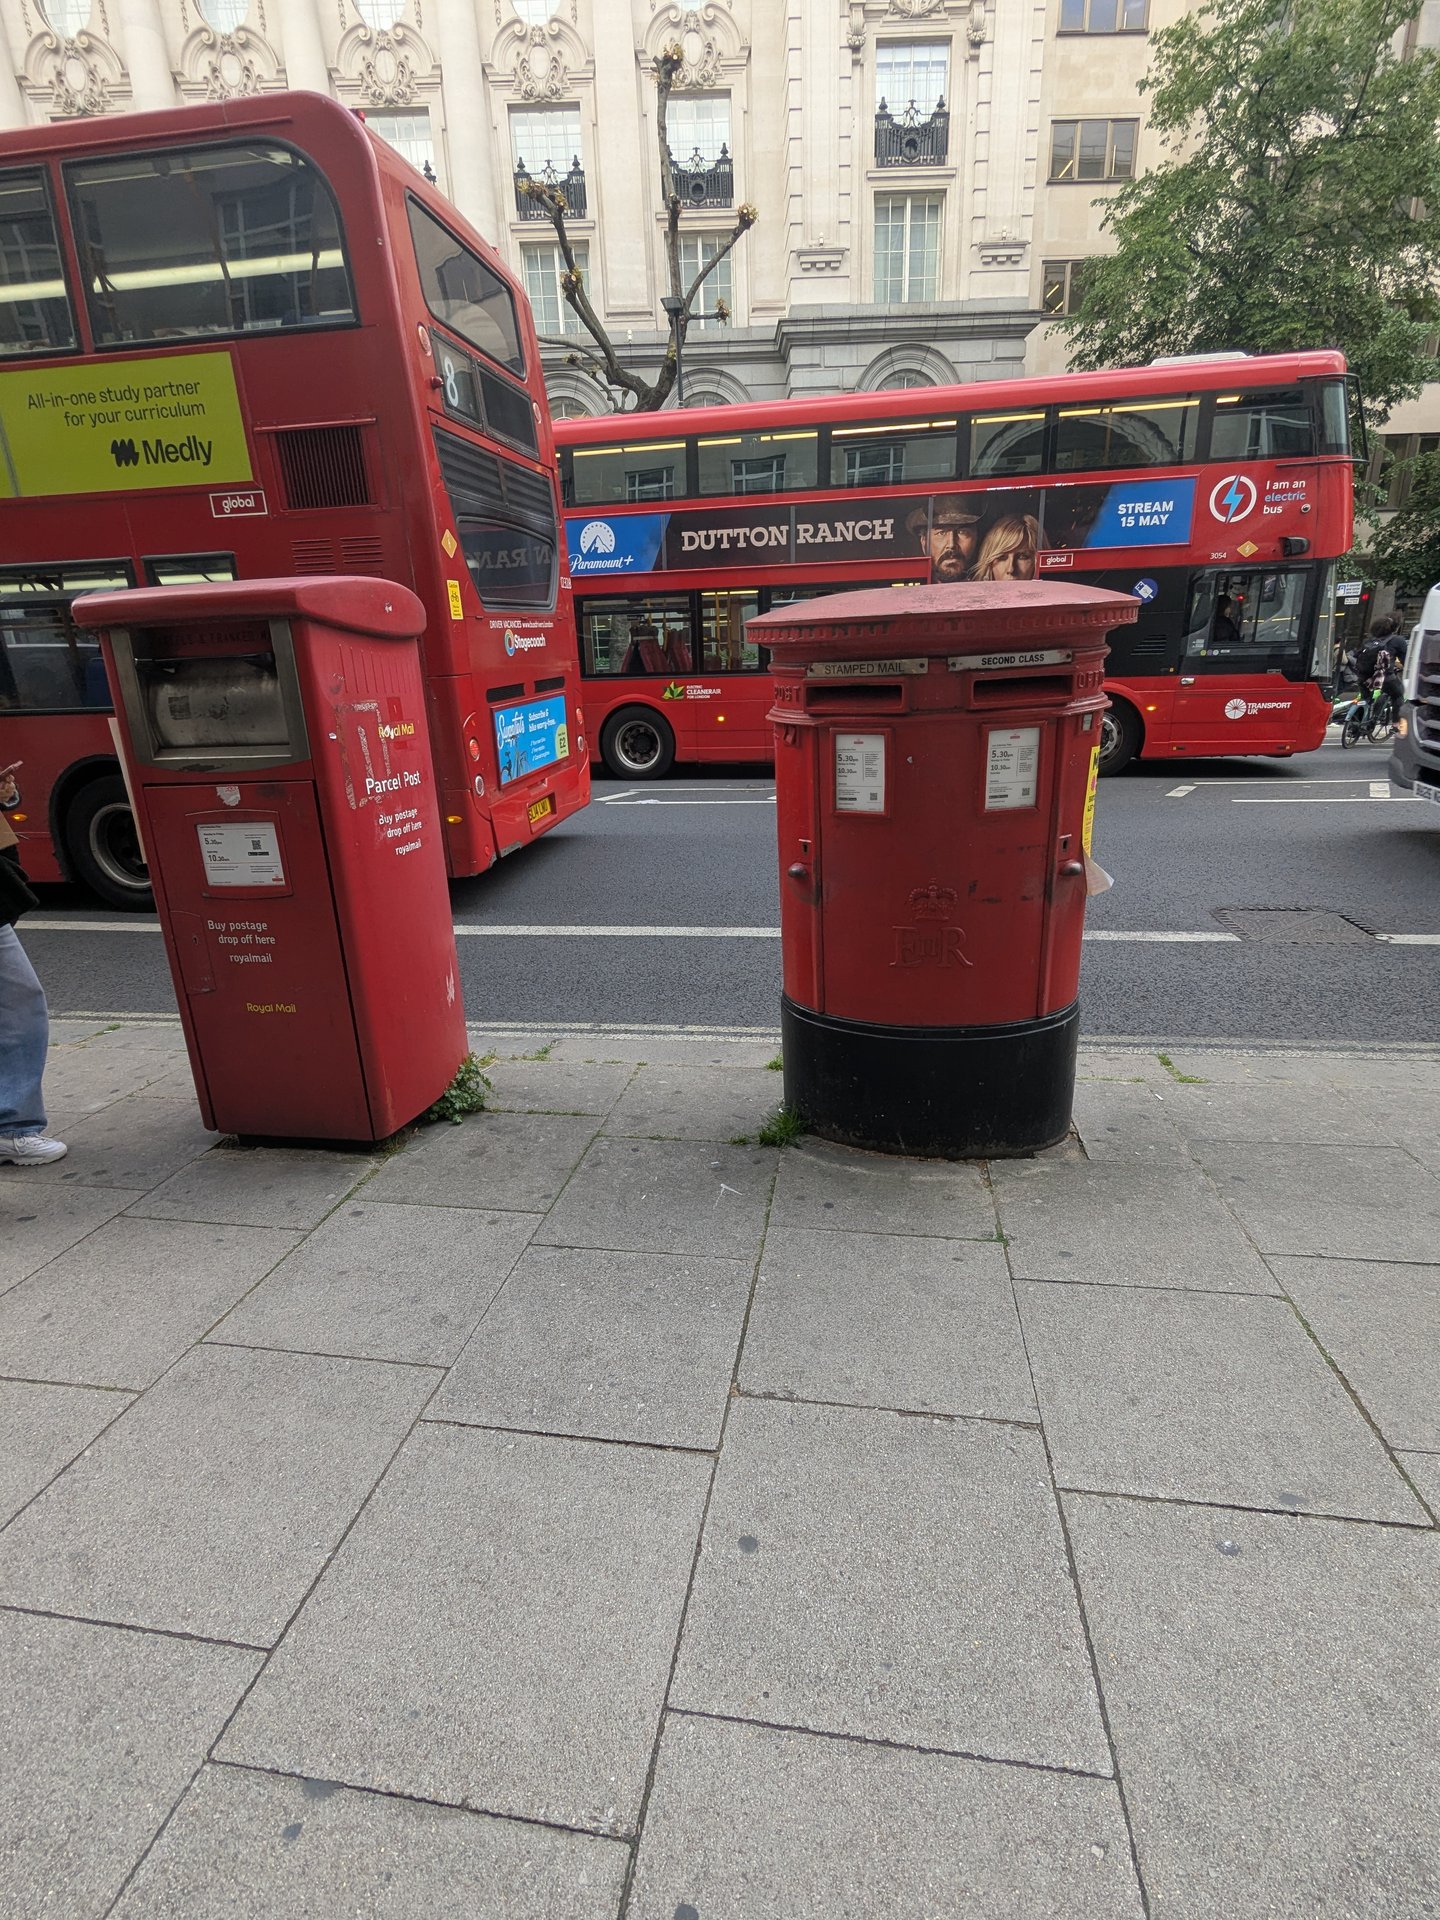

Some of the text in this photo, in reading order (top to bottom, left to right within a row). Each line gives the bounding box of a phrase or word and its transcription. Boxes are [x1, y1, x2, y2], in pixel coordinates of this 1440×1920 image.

[444, 356, 458, 407] 8
[28, 382, 200, 410] All-in-one study partner
[64, 402, 206, 428] for your curriculum
[142, 435, 212, 466] Medly
[1266, 480, 1270, 490] I
[1272, 482, 1290, 490] am
[1264, 492, 1306, 503] electric
[222, 496, 255, 513] global
[1118, 501, 1174, 514] STREAM
[1263, 505, 1282, 514] bus
[1121, 514, 1169, 527] 15 MAY
[682, 518, 894, 551] DUTTON RANCH
[568, 554, 634, 573] Paramount+
[1047, 556, 1066, 565] global
[514, 633, 546, 652] Stagecoach
[981, 654, 1045, 666] SECOND CLASS
[824, 663, 904, 675] STAMPED MAIL
[774, 686, 800, 700] POST
[401, 723, 414, 735] Mail
[366, 770, 421, 794] Parcel Post
[379, 808, 417, 825] Buy postage
[387, 827, 402, 839] drop
[411, 820, 422, 832] here
[395, 838, 422, 856] royalmail
[208, 920, 268, 932] Buy postage
[218, 935, 276, 946] drop off here
[230, 953, 272, 964] royalmail
[246, 1003, 296, 1014] Royal Mail
